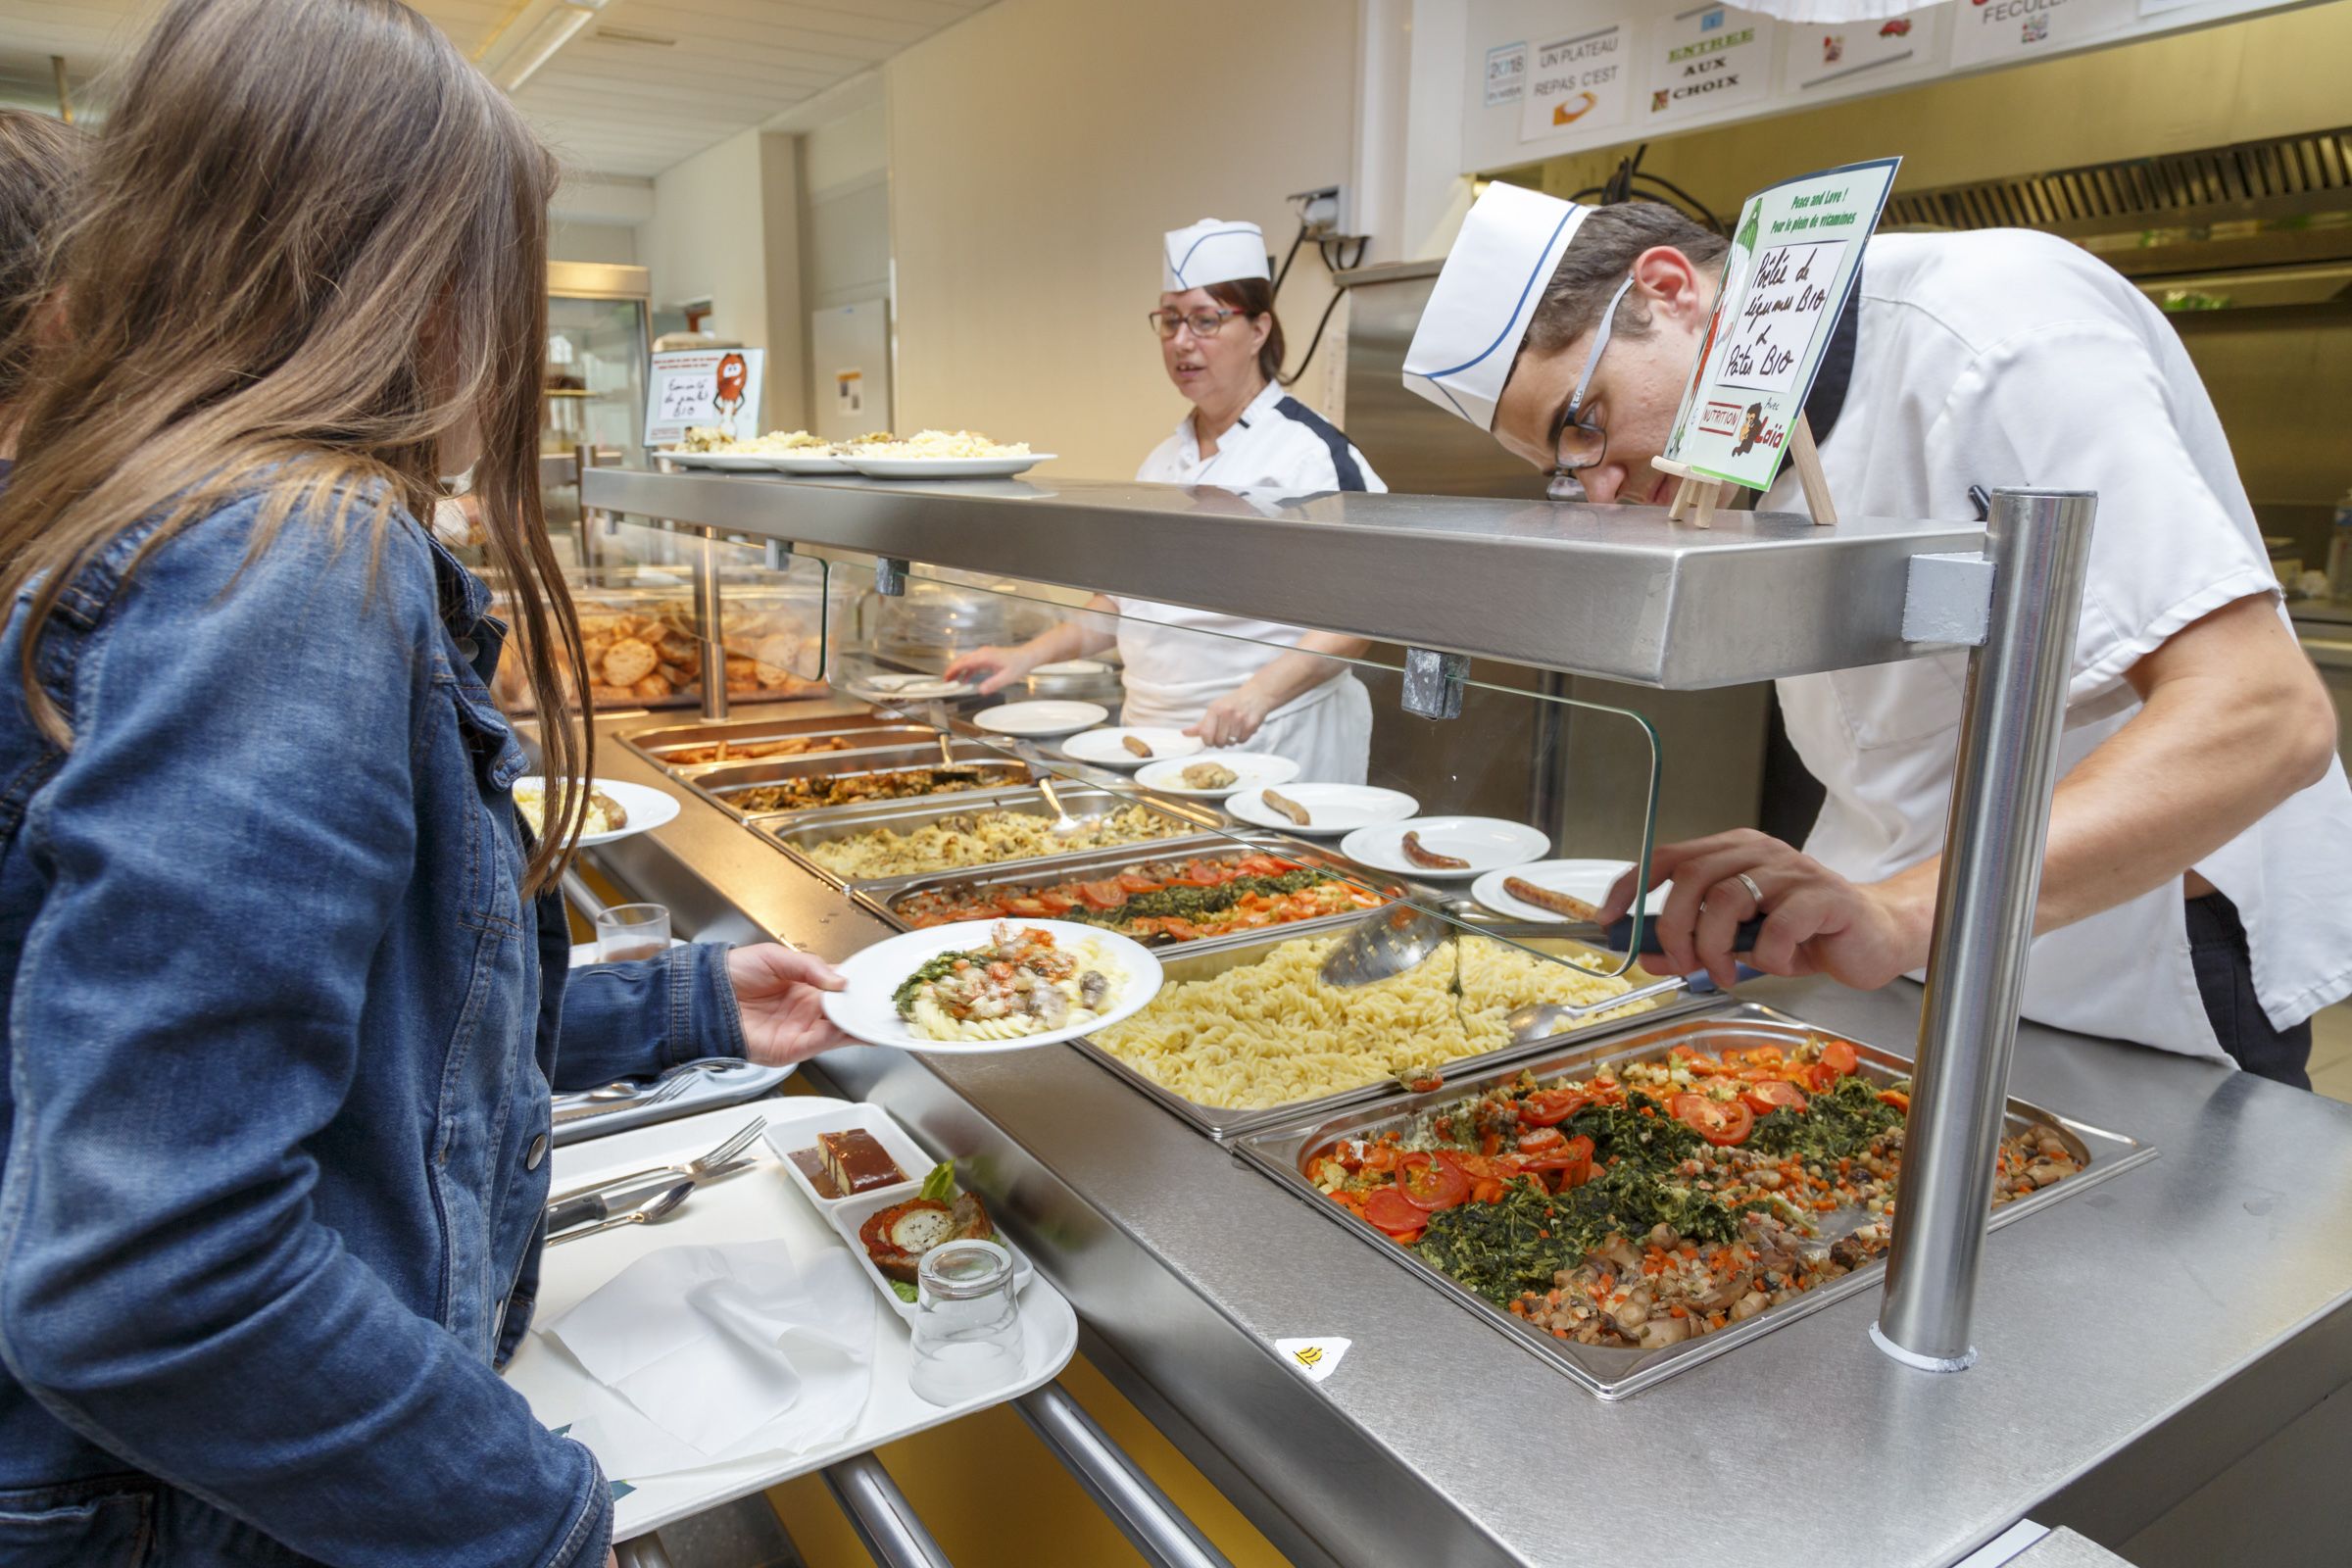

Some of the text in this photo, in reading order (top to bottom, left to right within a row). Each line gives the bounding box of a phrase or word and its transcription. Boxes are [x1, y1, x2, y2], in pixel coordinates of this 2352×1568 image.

[1540, 50, 1558, 69] UN
[1561, 37, 1619, 62] PLATEAU
[1668, 27, 1755, 63] ENTREE
[1535, 75, 1576, 96] REPAS
[1582, 66, 1619, 87] C'EST
[1684, 57, 1726, 77] AUX
[1673, 74, 1739, 99] CHOIX
[1790, 195, 1810, 210] Peace
[1810, 191, 1825, 207] and
[1824, 190, 1842, 205] Love
[1770, 212, 1857, 234] Pour le plein de vitamines
[1795, 247, 1818, 282] de
[1795, 284, 1826, 313] BIO
[1725, 344, 1793, 376] Pâtes BIO
[1703, 409, 1739, 426] NUTRITION
[1764, 397, 1781, 411] Avec
[1754, 416, 1785, 449] Laïa
